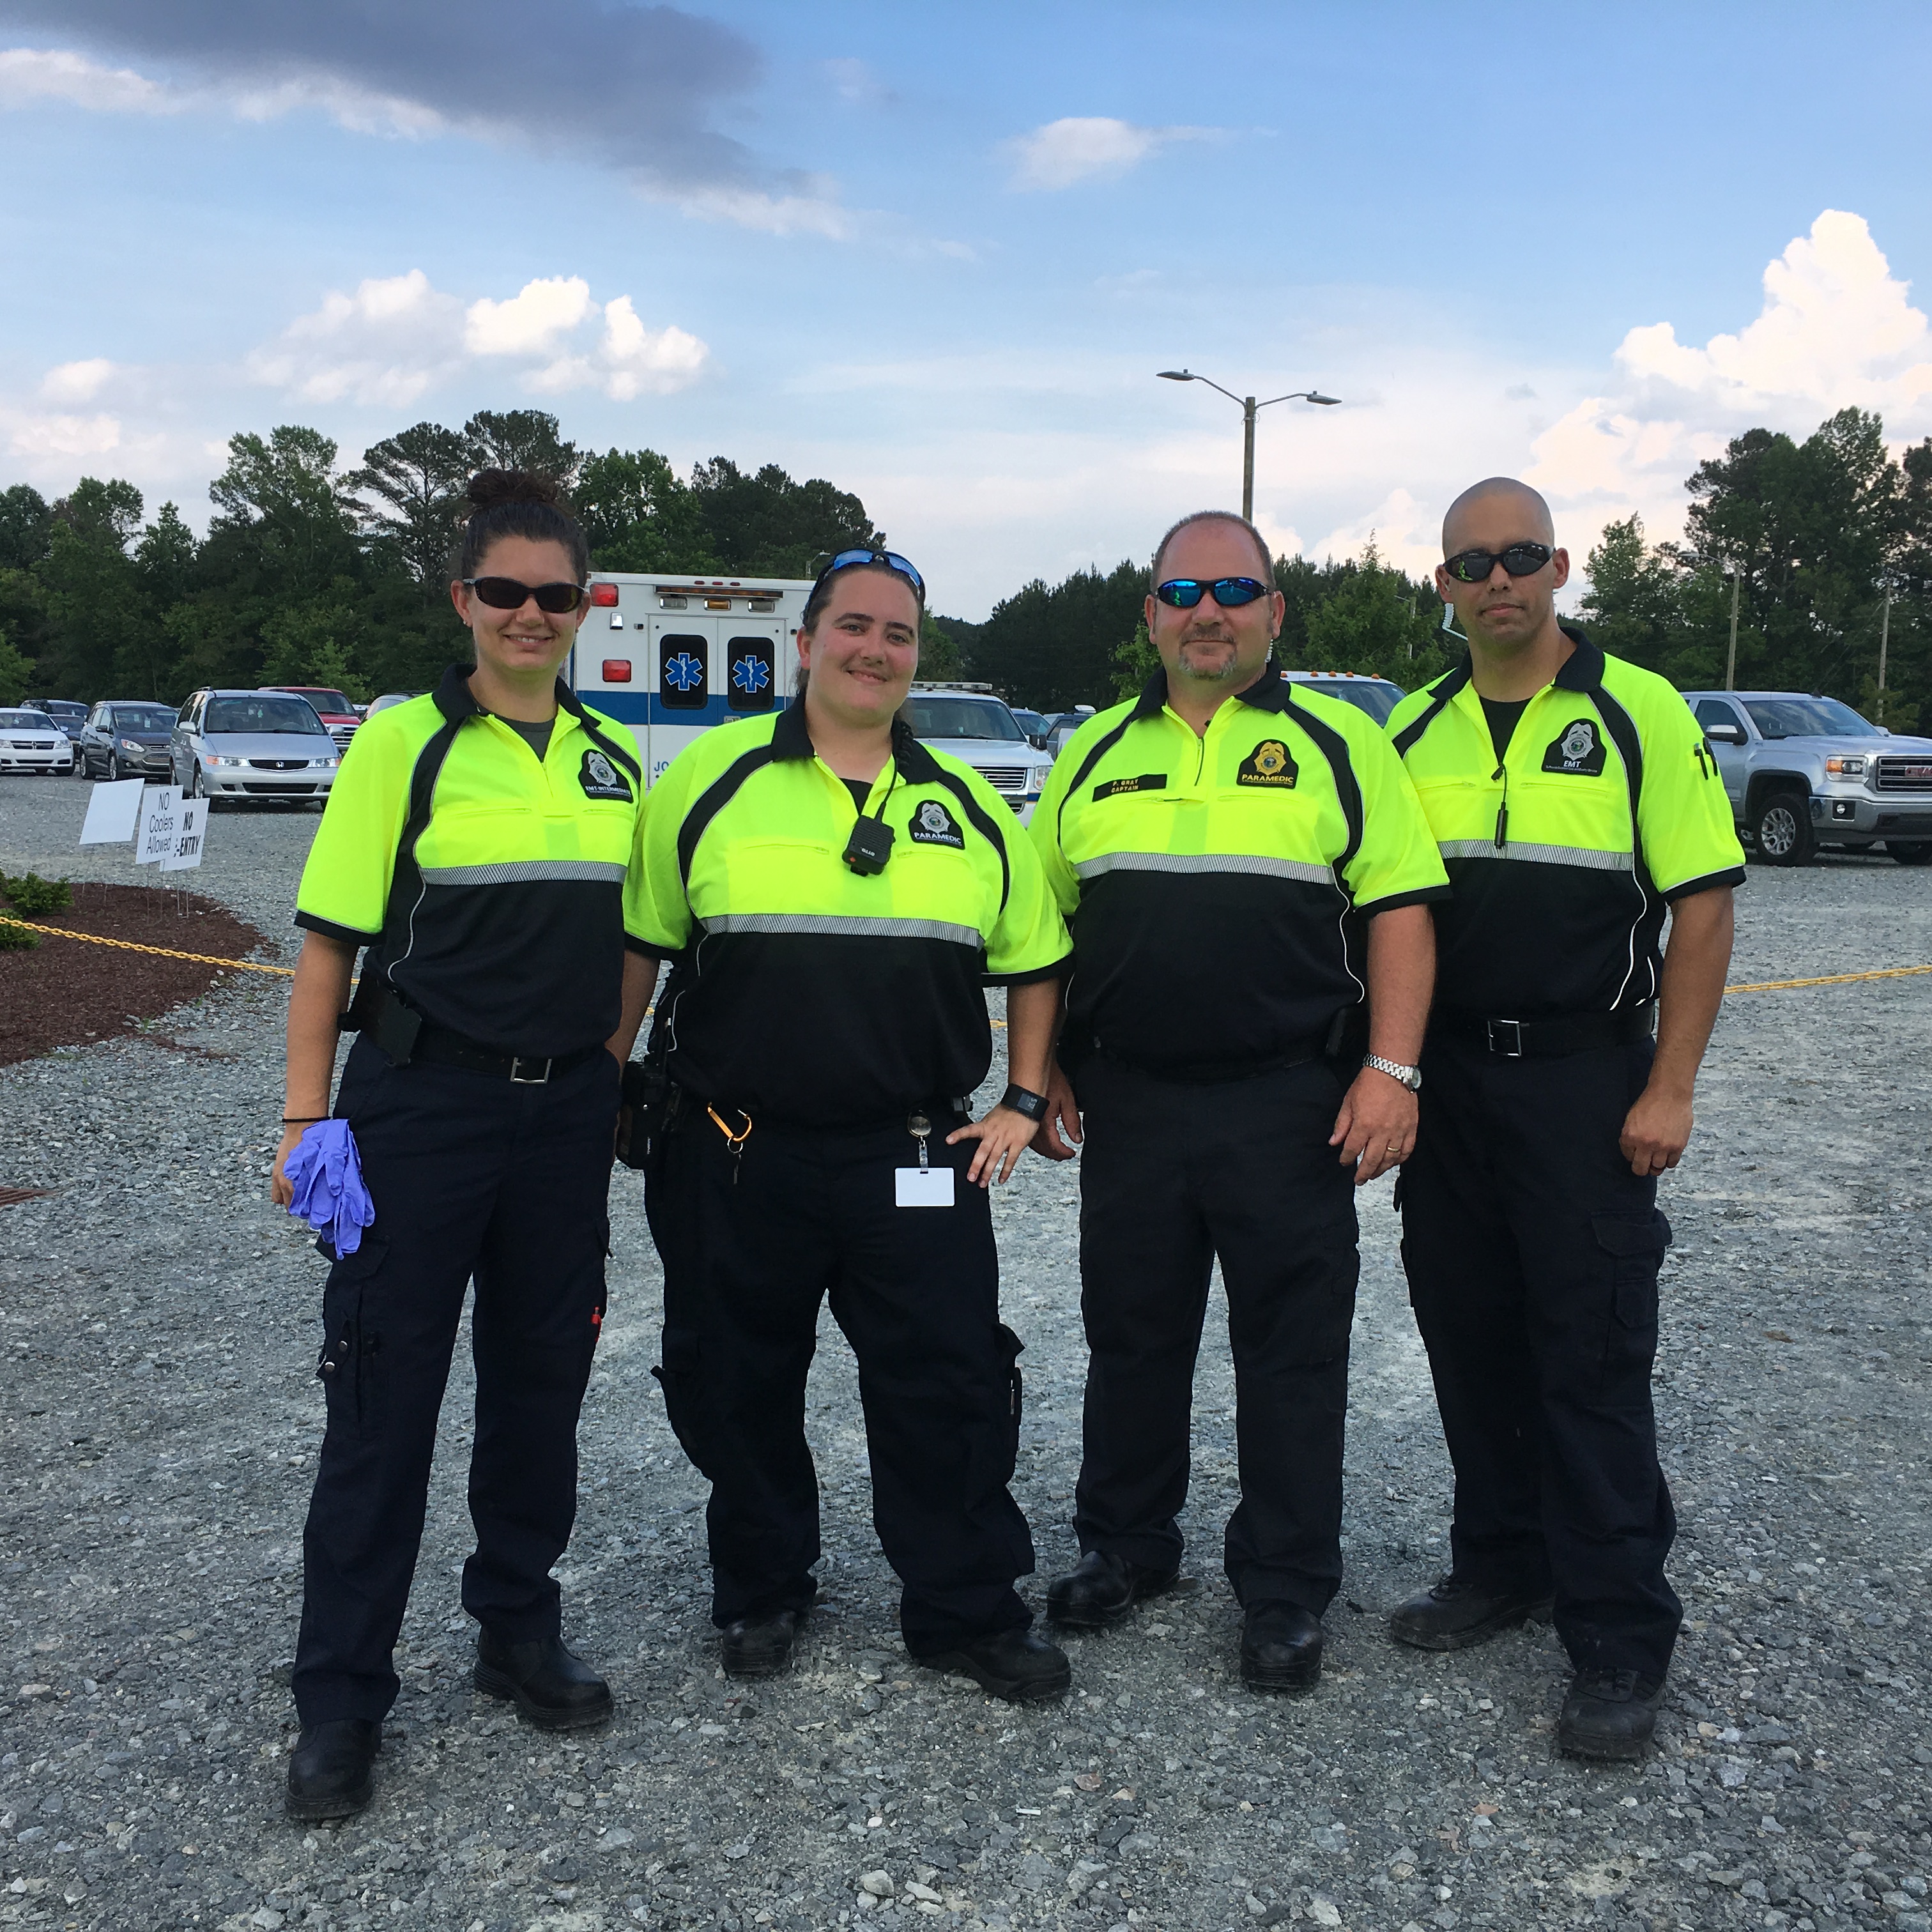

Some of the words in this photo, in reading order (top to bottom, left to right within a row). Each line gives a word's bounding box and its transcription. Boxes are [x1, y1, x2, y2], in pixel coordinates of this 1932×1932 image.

[1241, 774, 1294, 783] PARAMEDIC
[158, 792, 170, 811] NO
[149, 813, 174, 833] Coolers
[183, 811, 194, 831] NO
[146, 832, 172, 854] Allowed
[914, 832, 962, 844] PARAMEDIC
